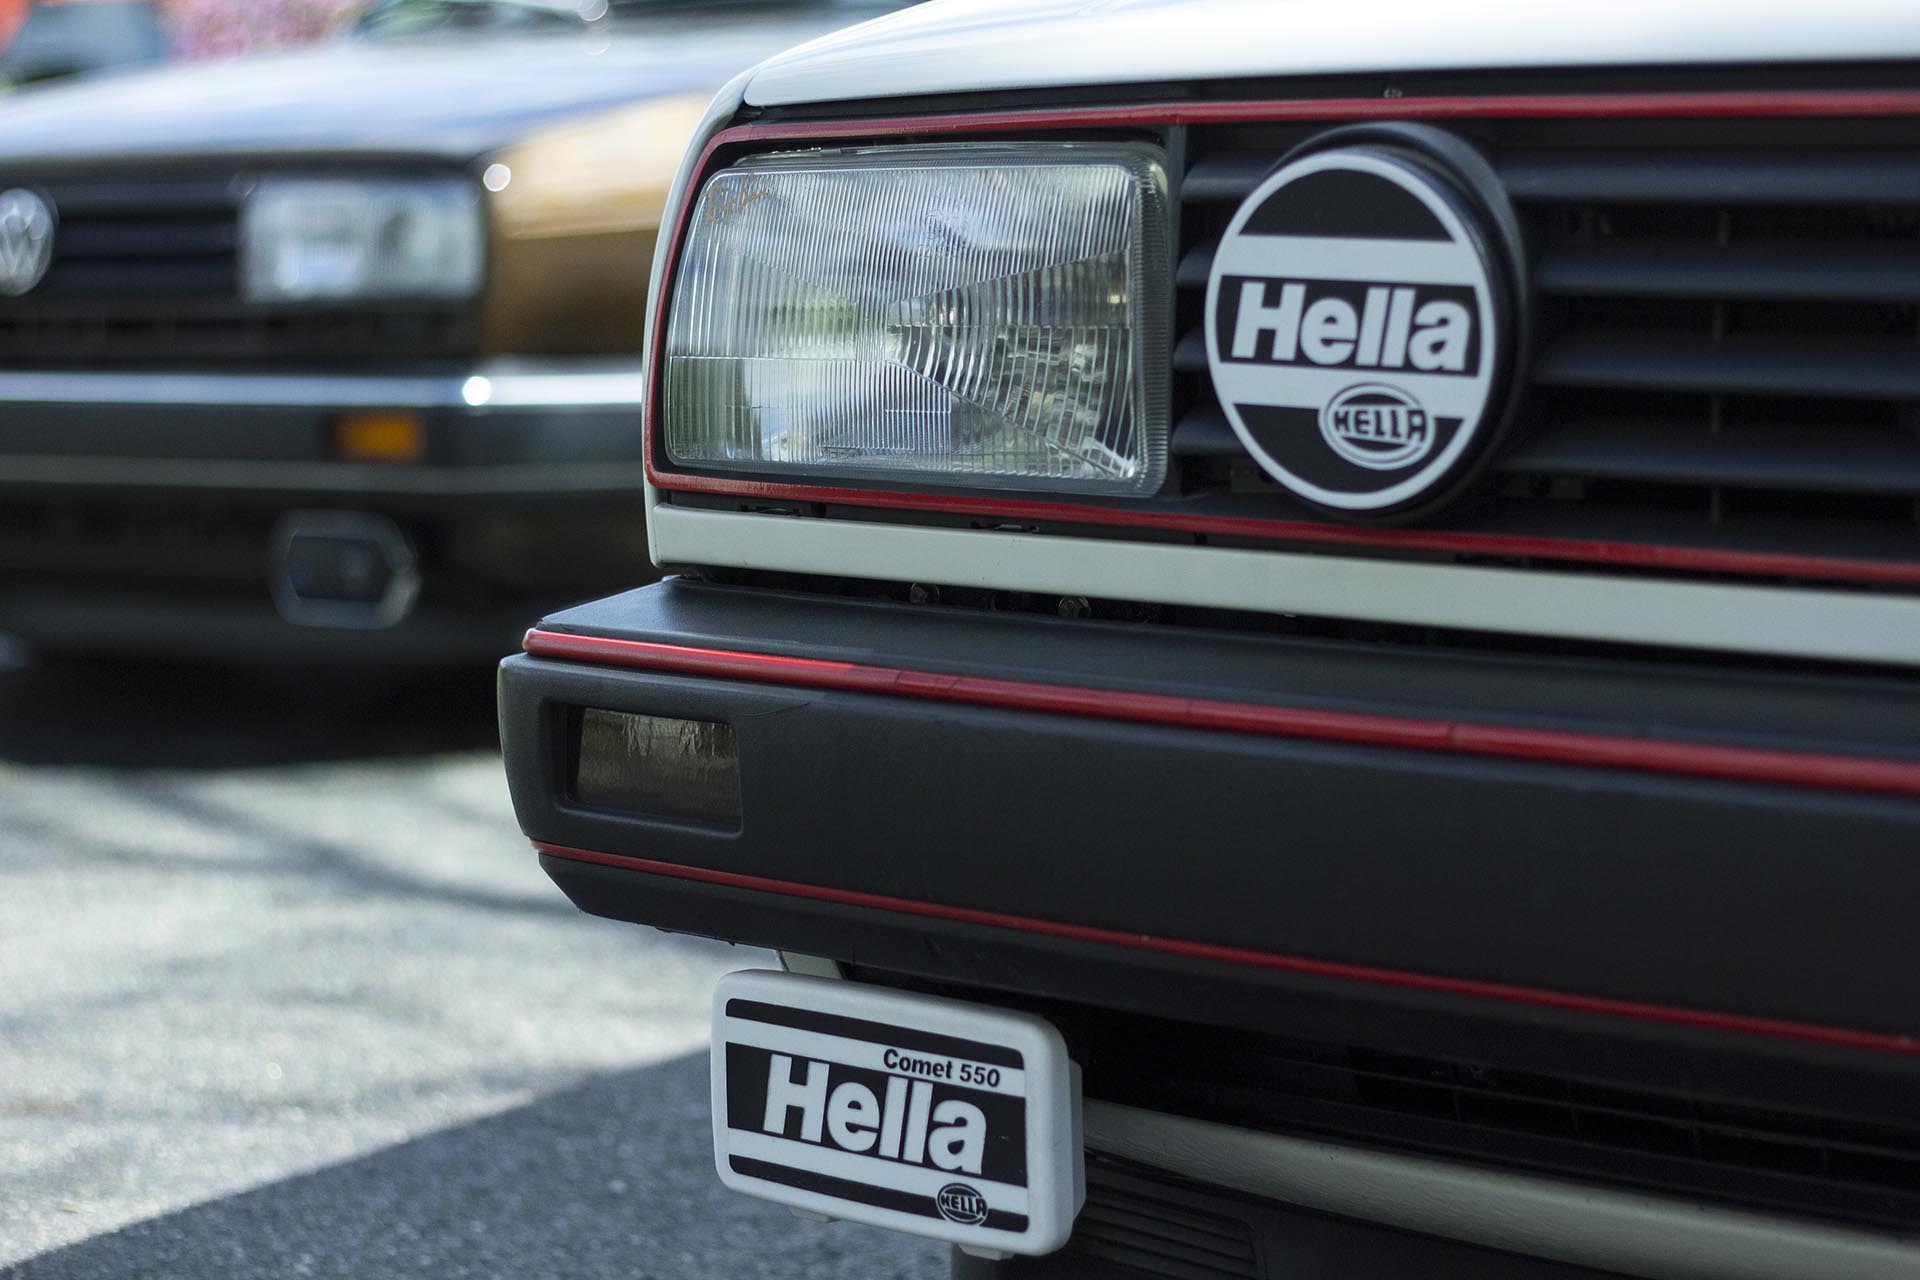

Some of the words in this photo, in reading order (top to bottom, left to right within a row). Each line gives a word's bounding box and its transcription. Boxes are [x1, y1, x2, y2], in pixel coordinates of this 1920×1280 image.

[1231, 281, 1471, 372] Hella
[1333, 409, 1426, 443] HELLA
[883, 1048, 953, 1080] Comet
[960, 1063, 1001, 1088] 550
[762, 1053, 988, 1175] Hella
[940, 1194, 988, 1217] HELLA
